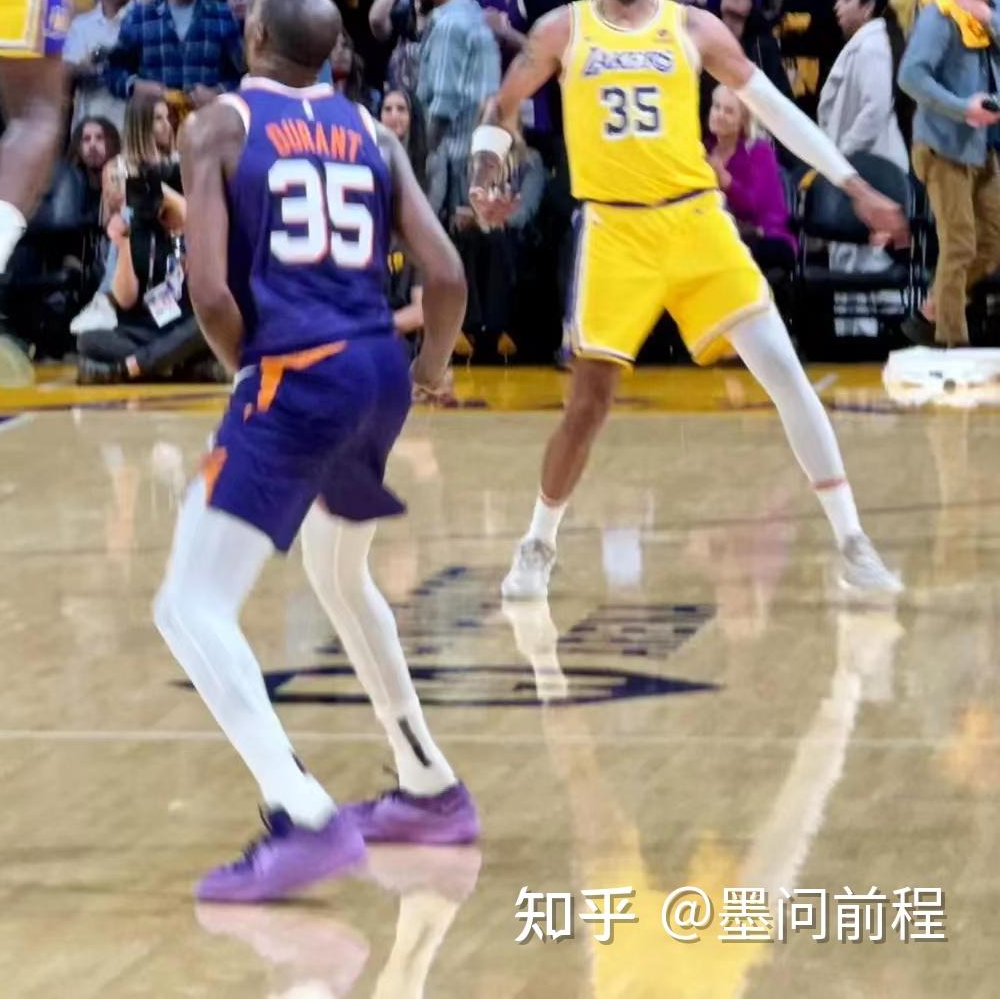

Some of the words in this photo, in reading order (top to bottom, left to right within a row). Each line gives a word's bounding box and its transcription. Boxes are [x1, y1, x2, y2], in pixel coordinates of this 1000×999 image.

[600, 86, 661, 136] 35
[265, 118, 363, 163] DURANT
[267, 157, 375, 270] 35
